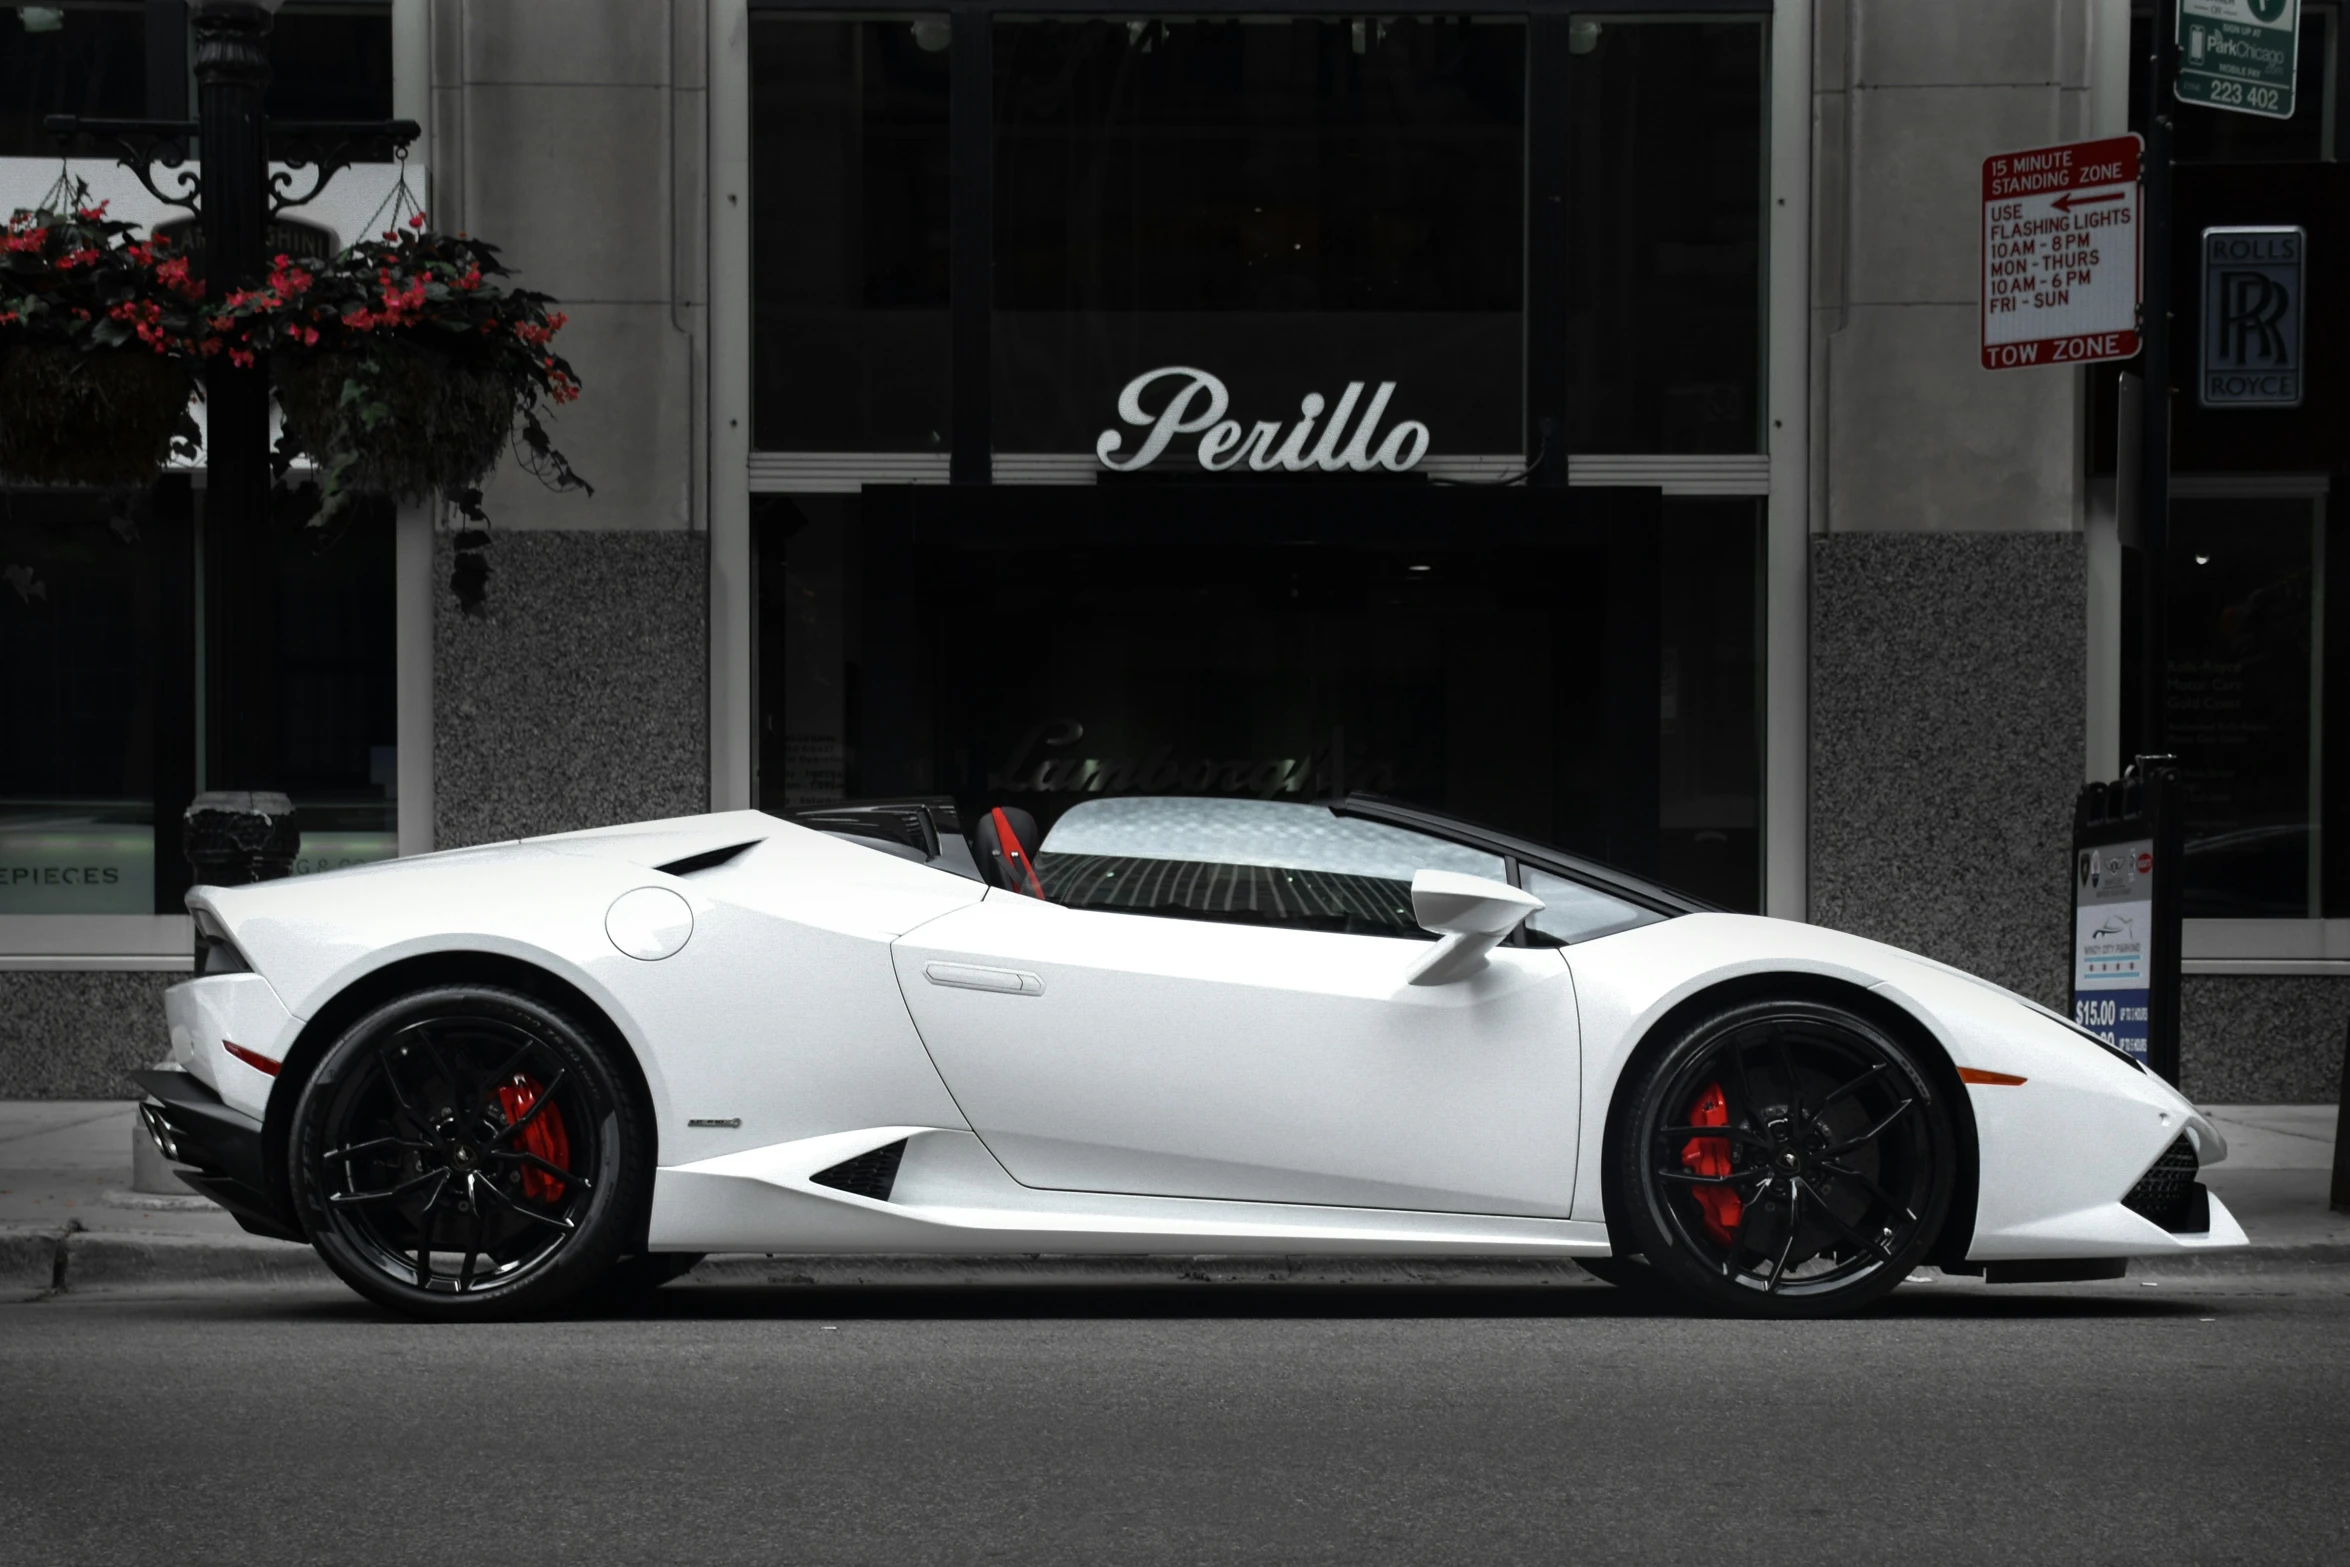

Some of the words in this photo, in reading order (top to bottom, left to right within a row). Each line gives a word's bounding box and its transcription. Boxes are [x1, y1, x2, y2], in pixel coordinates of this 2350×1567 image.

[2241, 27, 2252, 36] UP
[2252, 28, 2262, 38] AT
[2207, 34, 2285, 66] ParkChicago
[2219, 63, 2247, 77] MOBILE
[2247, 68, 2261, 78] PAY
[2210, 79, 2243, 105] 223
[2247, 86, 2279, 110] 402
[1991, 159, 2008, 177] 15
[2013, 150, 2073, 172] MINUTE
[1991, 169, 2070, 196] STANDING
[2079, 162, 2123, 184] ZONE
[1991, 203, 2023, 222] USE
[1991, 216, 2070, 241] FLASHING
[2074, 208, 2131, 230] LIGHTS
[2213, 239, 2294, 259] ROLLS
[1991, 259, 2027, 277] MON
[2042, 249, 2100, 271] THURS
[1990, 296, 2016, 314] FRI
[2034, 290, 2069, 309] SUN
[1986, 342, 2039, 368] TOW
[2052, 333, 2121, 361] ZONE
[2211, 375, 2292, 396] ROYCE
[1096, 366, 1430, 472] Perillo
[2075, 1000, 2116, 1026] $15.00
